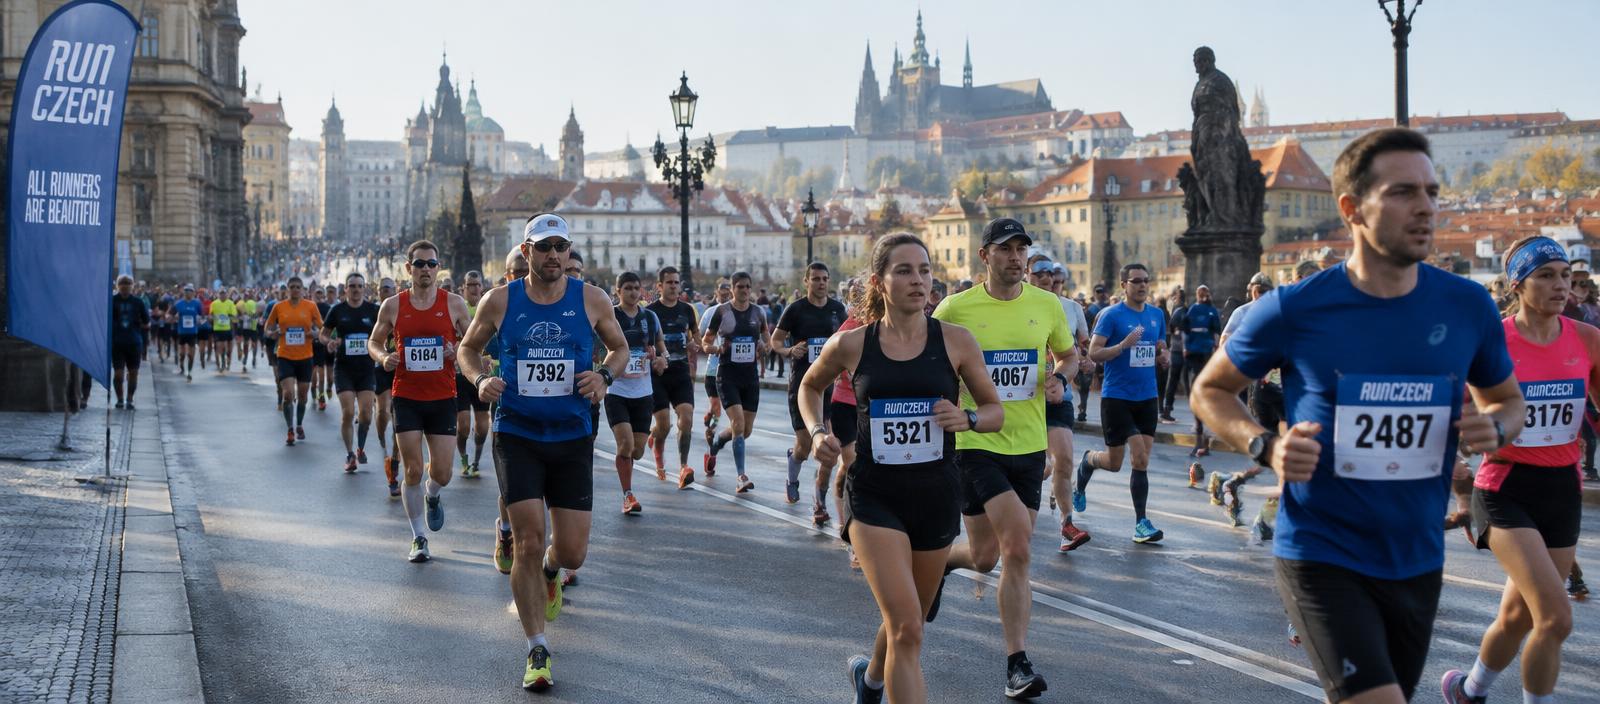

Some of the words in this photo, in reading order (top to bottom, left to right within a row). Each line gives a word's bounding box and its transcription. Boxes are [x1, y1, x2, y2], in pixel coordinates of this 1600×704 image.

[44, 40, 115, 85] RUN
[31, 85, 114, 126] CZECH
[27, 170, 47, 196] ALL
[50, 171, 101, 198] RUNNERS
[25, 198, 45, 224] ARE
[48, 199, 101, 226] BEAUTIFUL
[410, 347, 437, 361] 6184
[526, 363, 565, 382] 7392
[992, 366, 1029, 387] 4067
[1360, 382, 1434, 402] RUNCZECH
[884, 401, 930, 415] RUNCZECH
[1524, 403, 1573, 428] 3176
[883, 420, 931, 445] 5321
[1354, 413, 1434, 449] 2487
